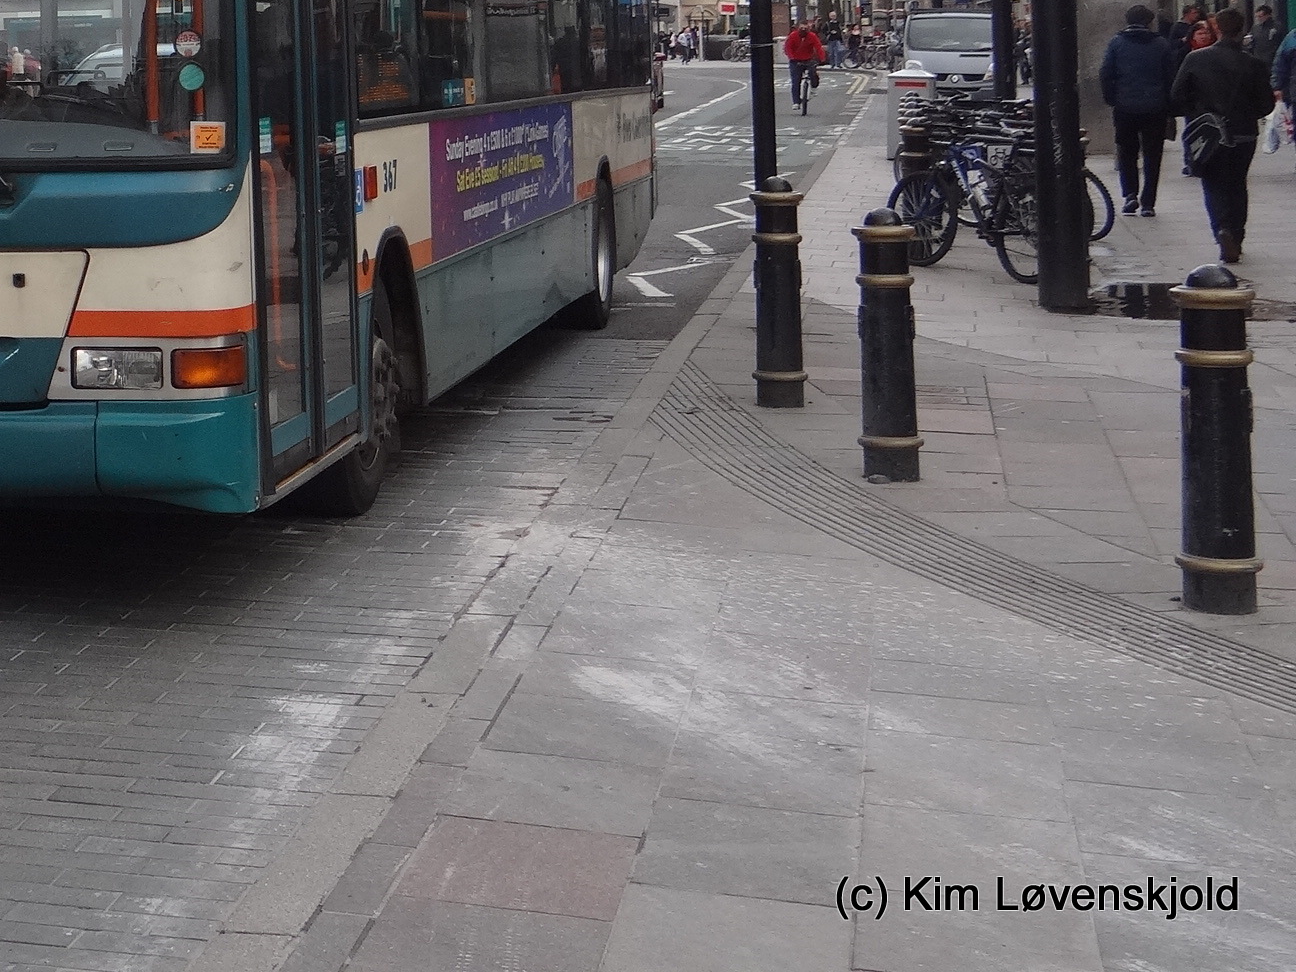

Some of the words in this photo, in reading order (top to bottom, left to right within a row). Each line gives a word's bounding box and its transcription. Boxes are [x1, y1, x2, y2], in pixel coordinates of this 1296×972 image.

[446, 137, 465, 164] Sunday
[465, 133, 483, 158] Evening
[382, 159, 398, 193] 367
